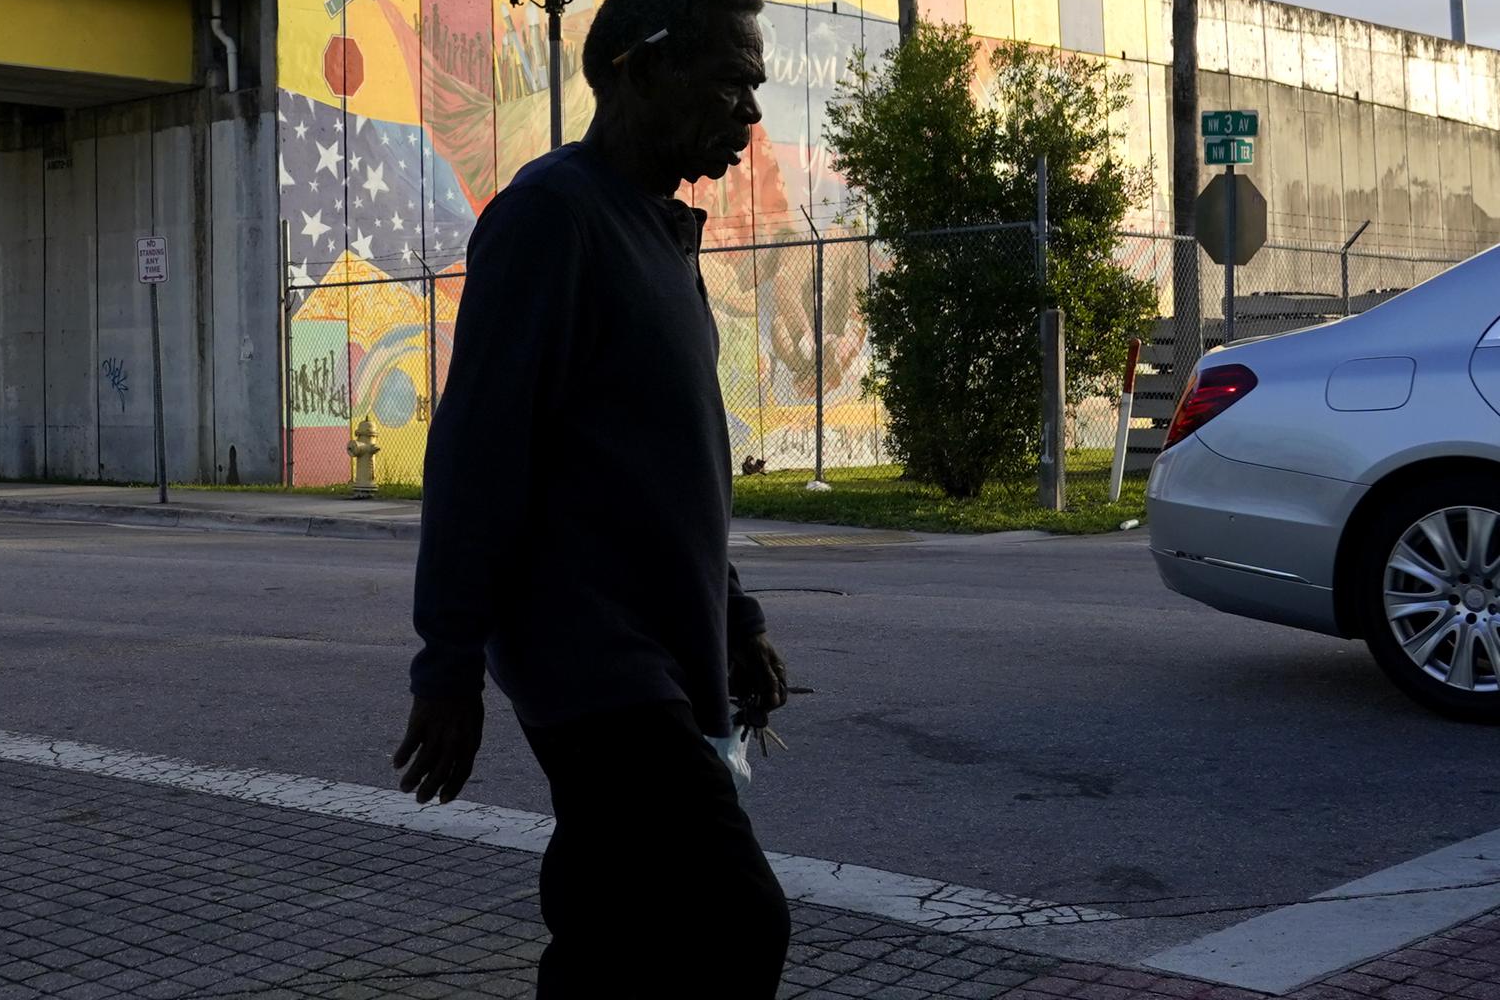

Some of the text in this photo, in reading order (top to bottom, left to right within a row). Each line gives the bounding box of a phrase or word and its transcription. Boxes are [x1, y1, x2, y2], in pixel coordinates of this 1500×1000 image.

[1208, 114, 1250, 134] NW 3 AV
[1212, 145, 1225, 160] NW
[146, 240, 157, 248] NO
[146, 257, 159, 265] ANY
[145, 266, 161, 274] TIME
